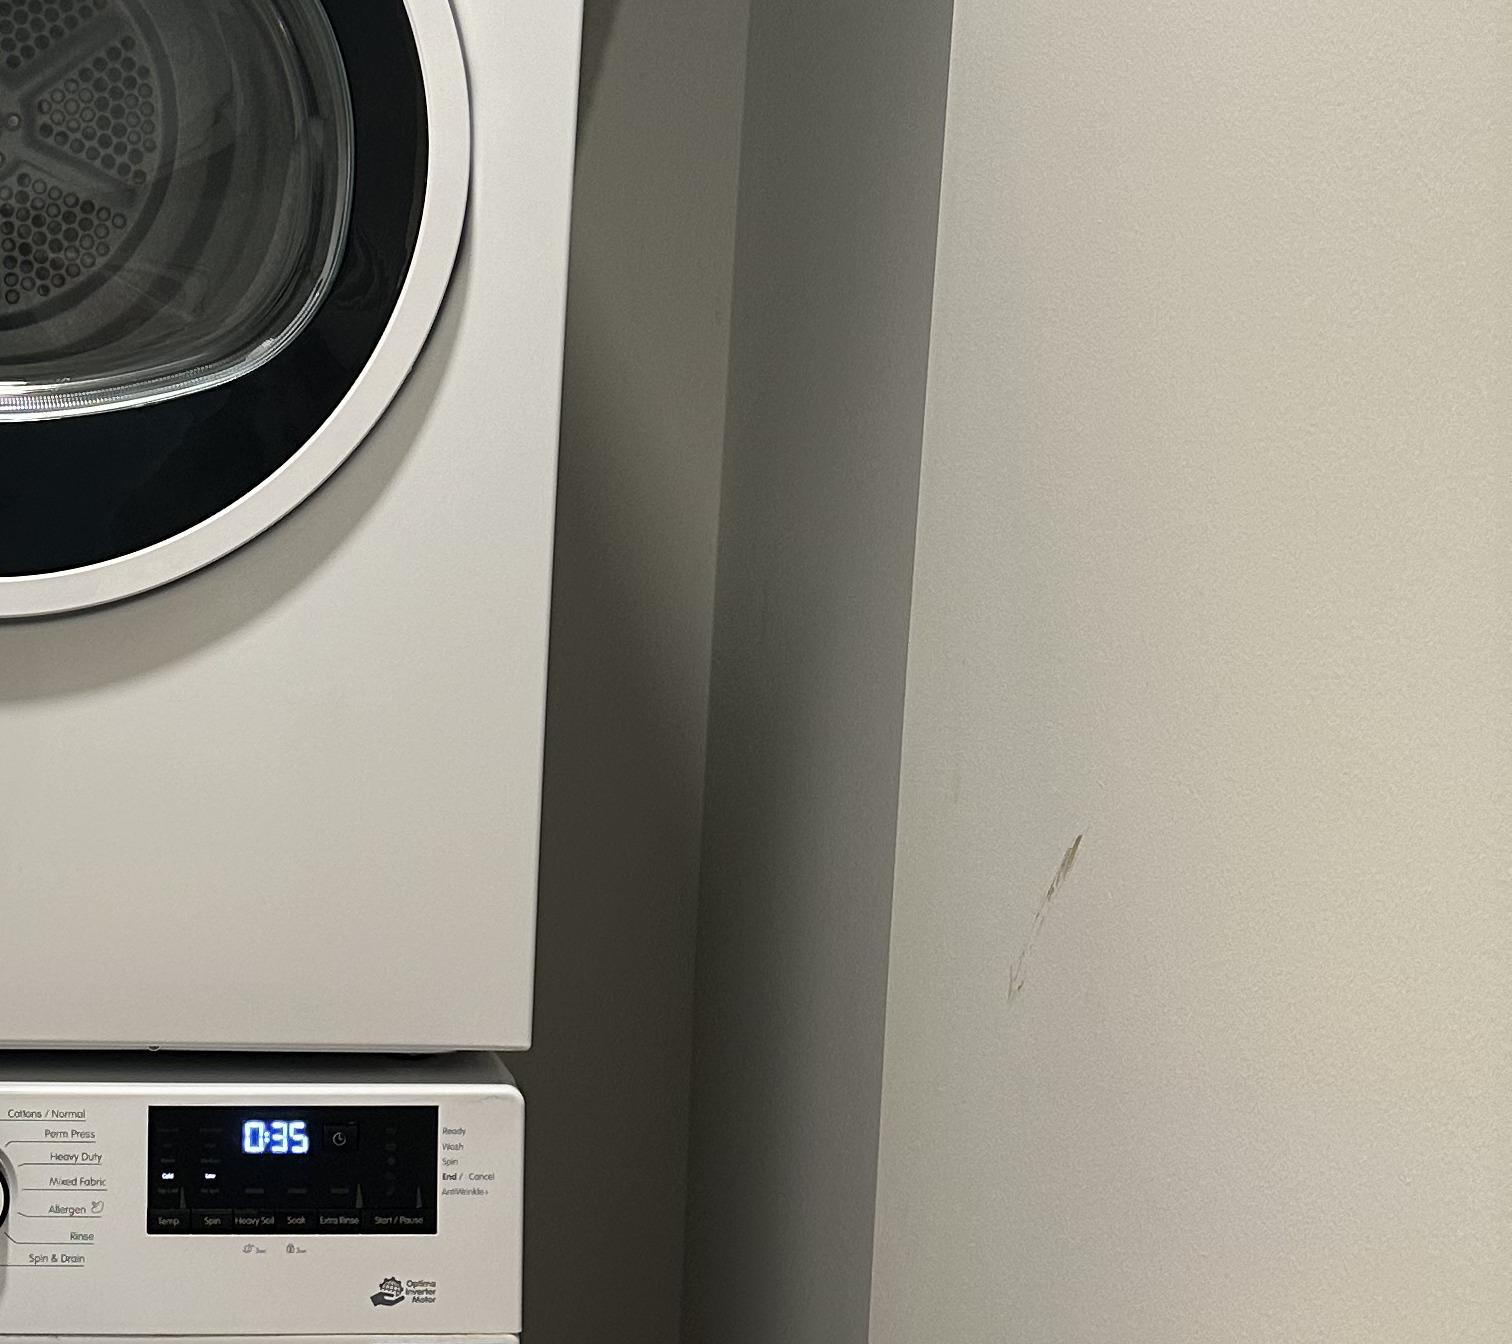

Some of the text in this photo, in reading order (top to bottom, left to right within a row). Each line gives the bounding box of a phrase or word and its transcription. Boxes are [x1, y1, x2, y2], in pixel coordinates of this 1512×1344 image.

[7, 1109, 42, 1119] Cottons
[51, 1109, 86, 1119] Normal
[44, 1129, 96, 1139] Perm Press
[442, 1127, 466, 1136] Ready
[243, 1120, 310, 1154] 0:35
[442, 1142, 464, 1151] Wash
[50, 1152, 102, 1164] Heavy Duty
[441, 1157, 459, 1166] Spin
[442, 1172, 457, 1181] End
[468, 1172, 495, 1181] Cancel
[49, 1177, 107, 1187] Mixed Fabric
[48, 1205, 87, 1216] Allergen
[158, 1216, 180, 1227] Temp
[204, 1216, 222, 1226] Spin
[234, 1216, 275, 1227] Heavy Soil
[287, 1215, 306, 1225] Soak
[319, 1216, 360, 1225] Extra Rinse
[374, 1215, 393, 1225] Start
[399, 1216, 424, 1225] Pause
[70, 1231, 95, 1241] Rinse
[28, 1253, 86, 1265] Spin & Drain
[405, 1279, 437, 1289] Optima
[405, 1288, 437, 1296] Inverter
[411, 1296, 436, 1304] Motor
